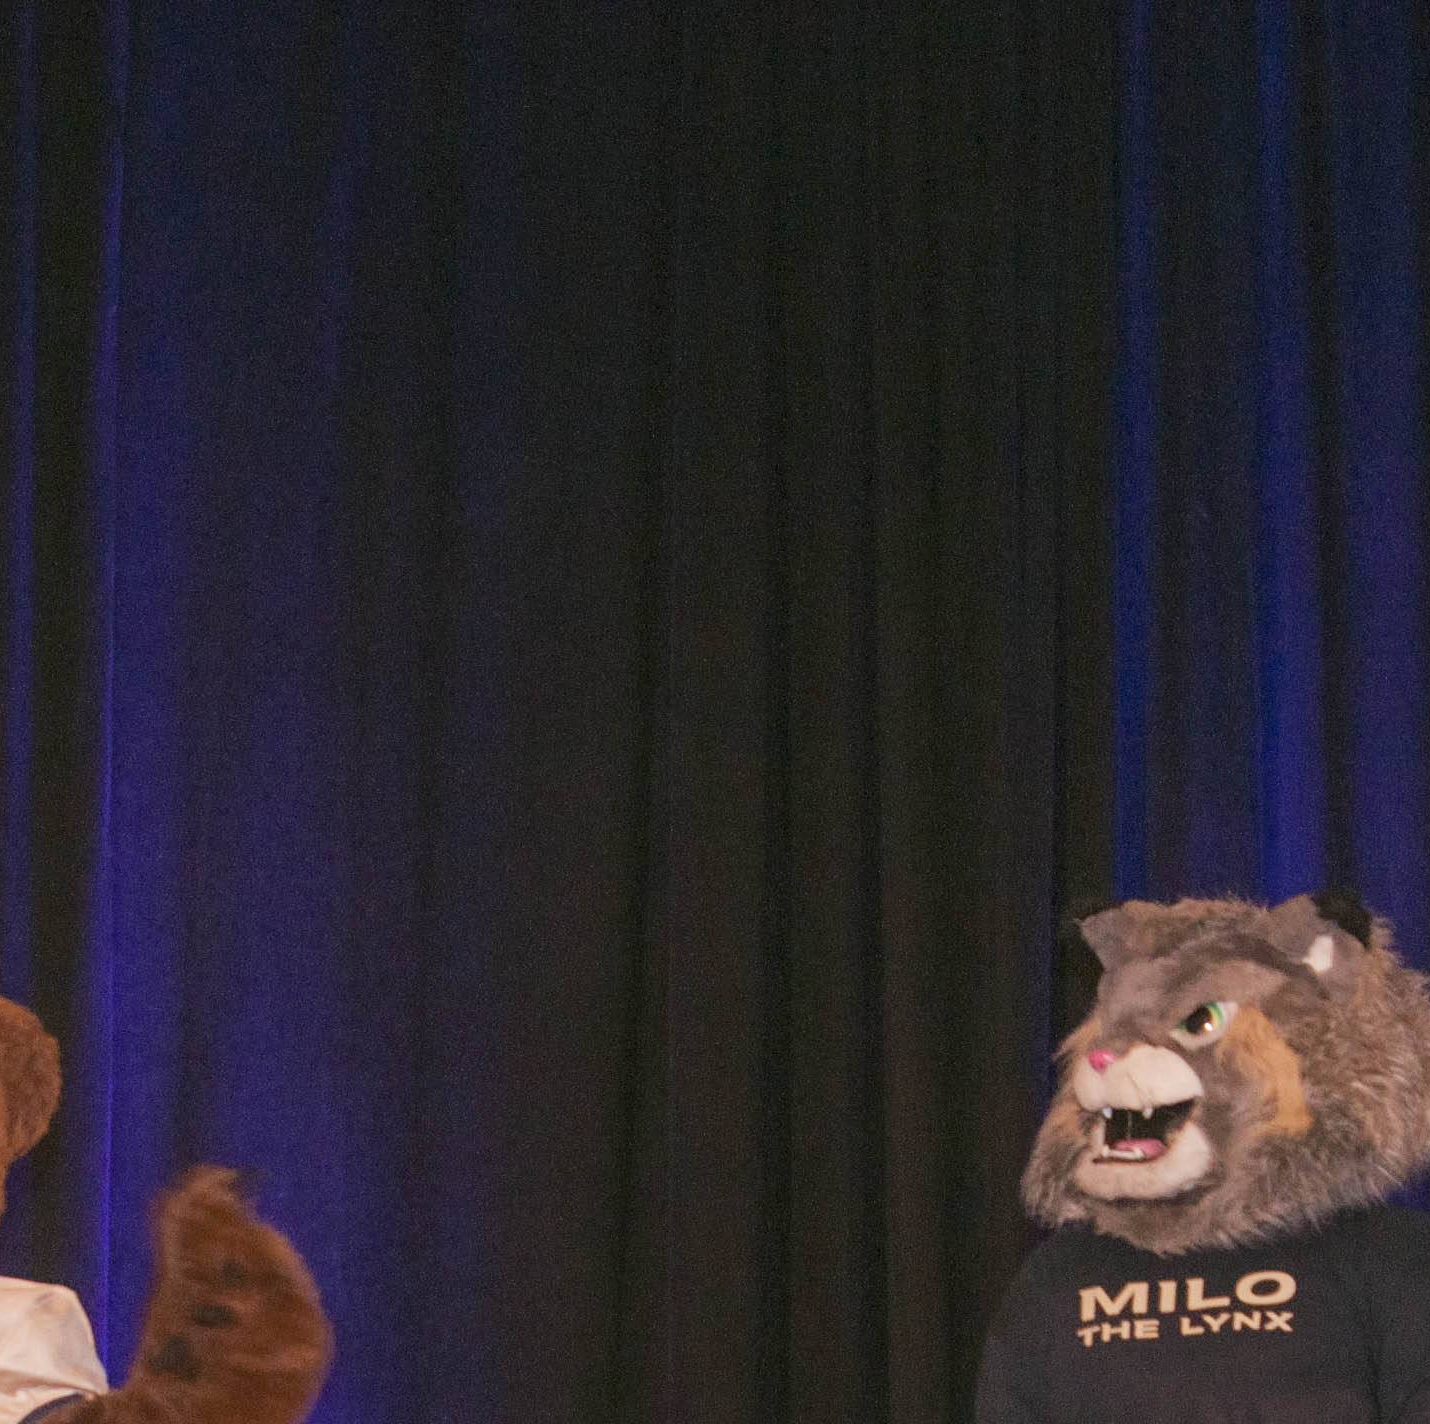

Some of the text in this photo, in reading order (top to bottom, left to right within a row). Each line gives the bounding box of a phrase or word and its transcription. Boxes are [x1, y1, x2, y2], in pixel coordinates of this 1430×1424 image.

[1078, 1269, 1297, 1322] MILO
[1076, 1310, 1294, 1347] THE LYNX
